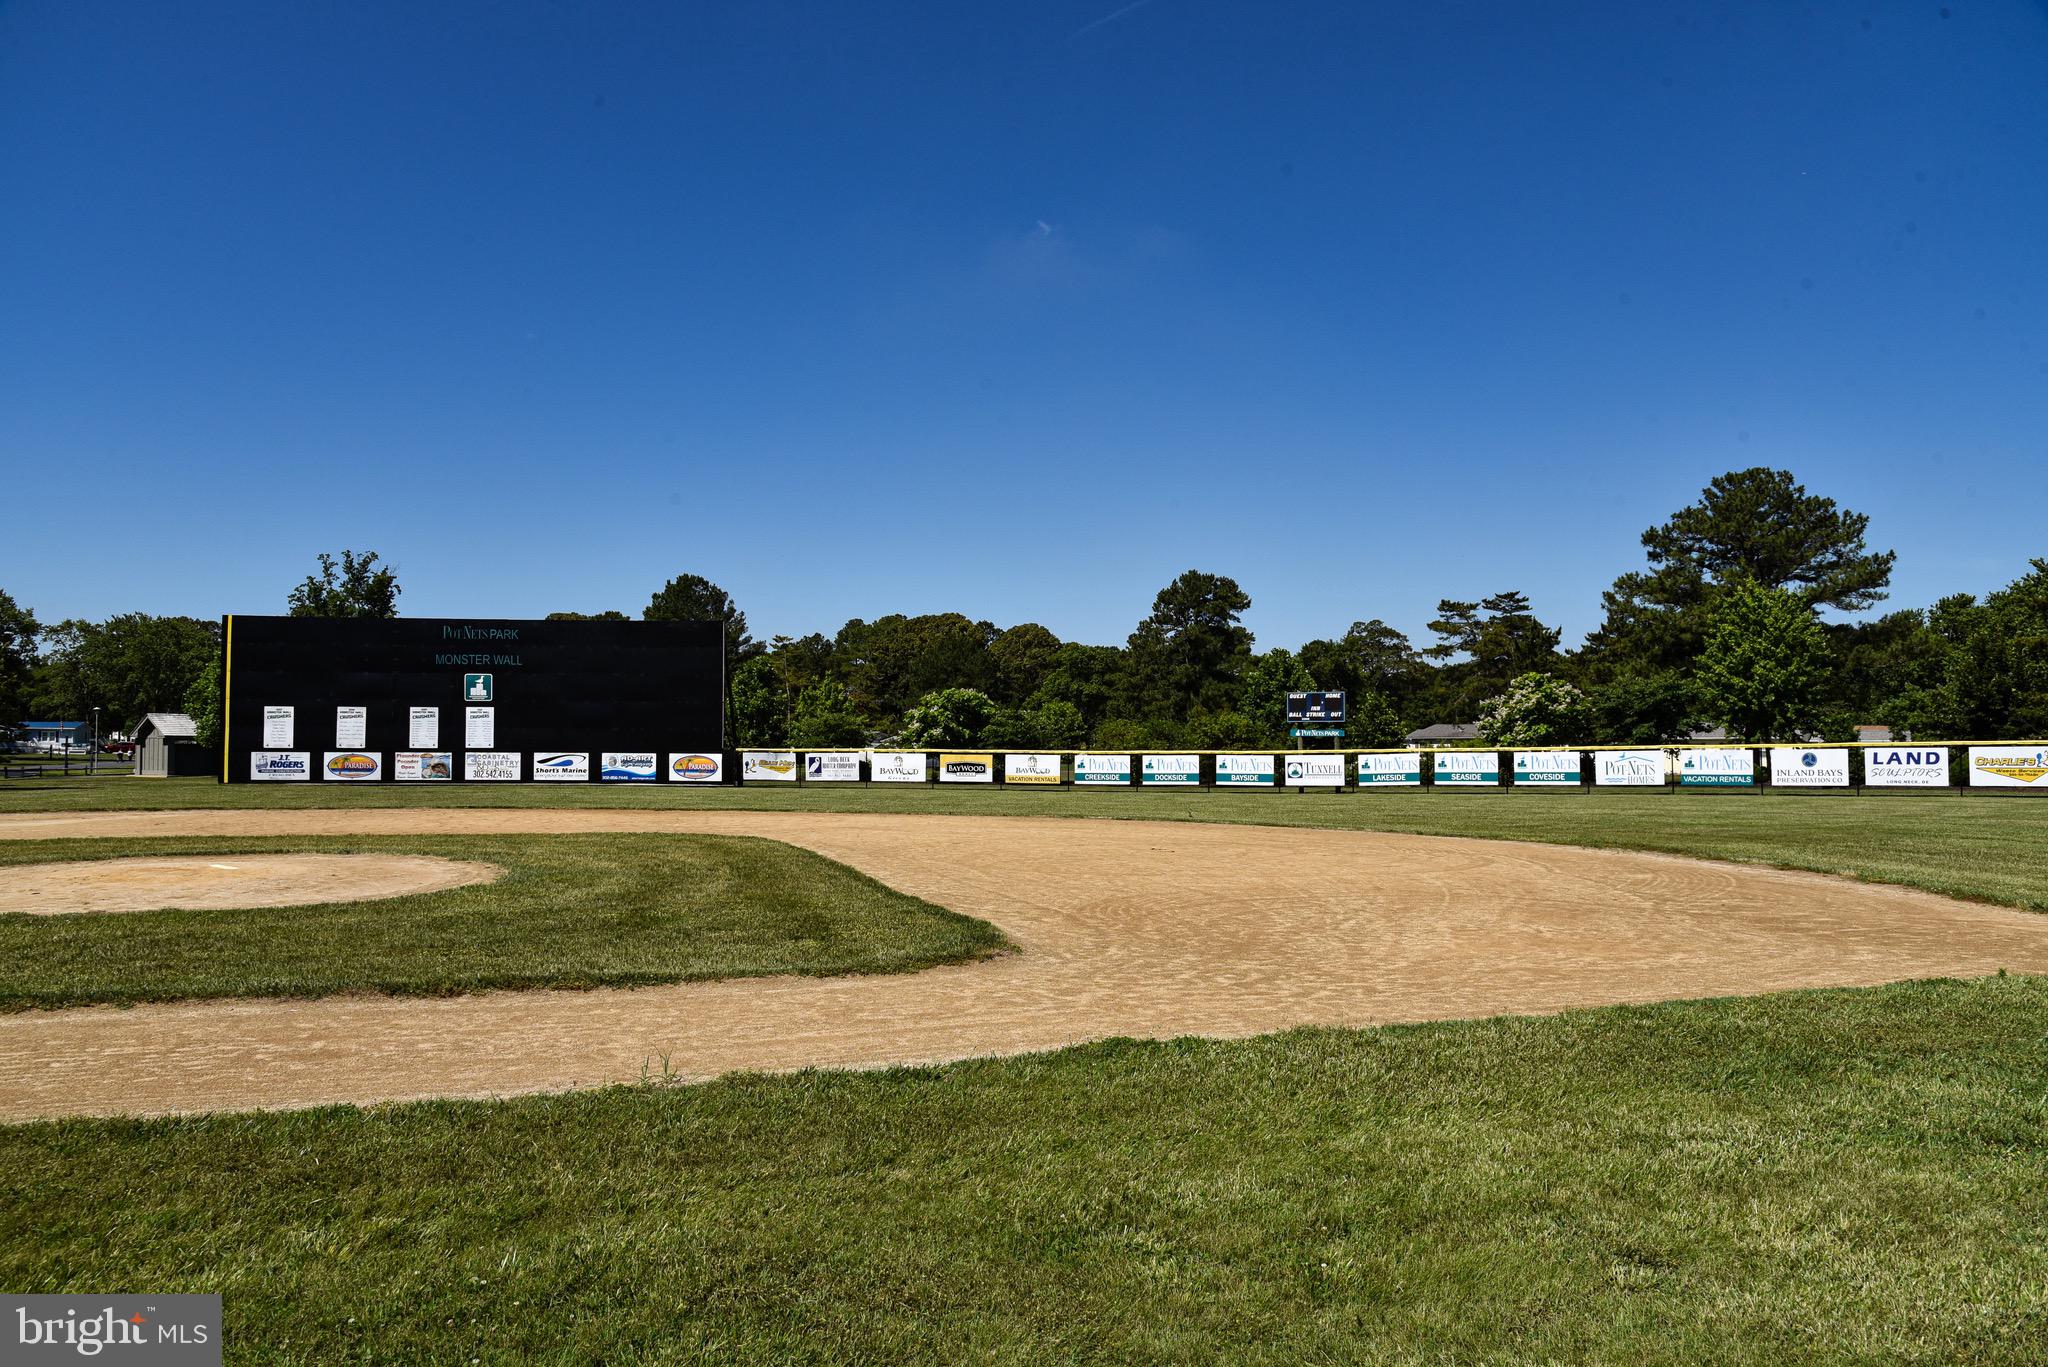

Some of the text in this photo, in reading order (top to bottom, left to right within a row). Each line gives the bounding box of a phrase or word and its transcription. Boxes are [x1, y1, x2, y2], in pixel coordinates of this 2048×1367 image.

[435, 654, 522, 666] MONSTER WALL
[1872, 752, 1941, 765] LAND
[1975, 757, 2036, 767] CHARLIE'S
[269, 760, 305, 769] ROGERS
[344, 761, 374, 769] PARADISE
[948, 764, 985, 772] BAYWOOD
[472, 769, 513, 779] 302.542.4155
[1776, 769, 1844, 777] INLAND BAYS
[1871, 767, 1943, 778] SCULPTORS
[1084, 773, 1120, 781] CREEKSIDE
[1231, 774, 1259, 782] BAYSIDE
[1372, 773, 1406, 781] LAKESIDE
[1451, 773, 1482, 781] SEASIDE
[1529, 773, 1565, 781] COVESIDE
[1627, 775, 1655, 784] HOMES
[1683, 775, 1752, 783] VACATION RENTALS
